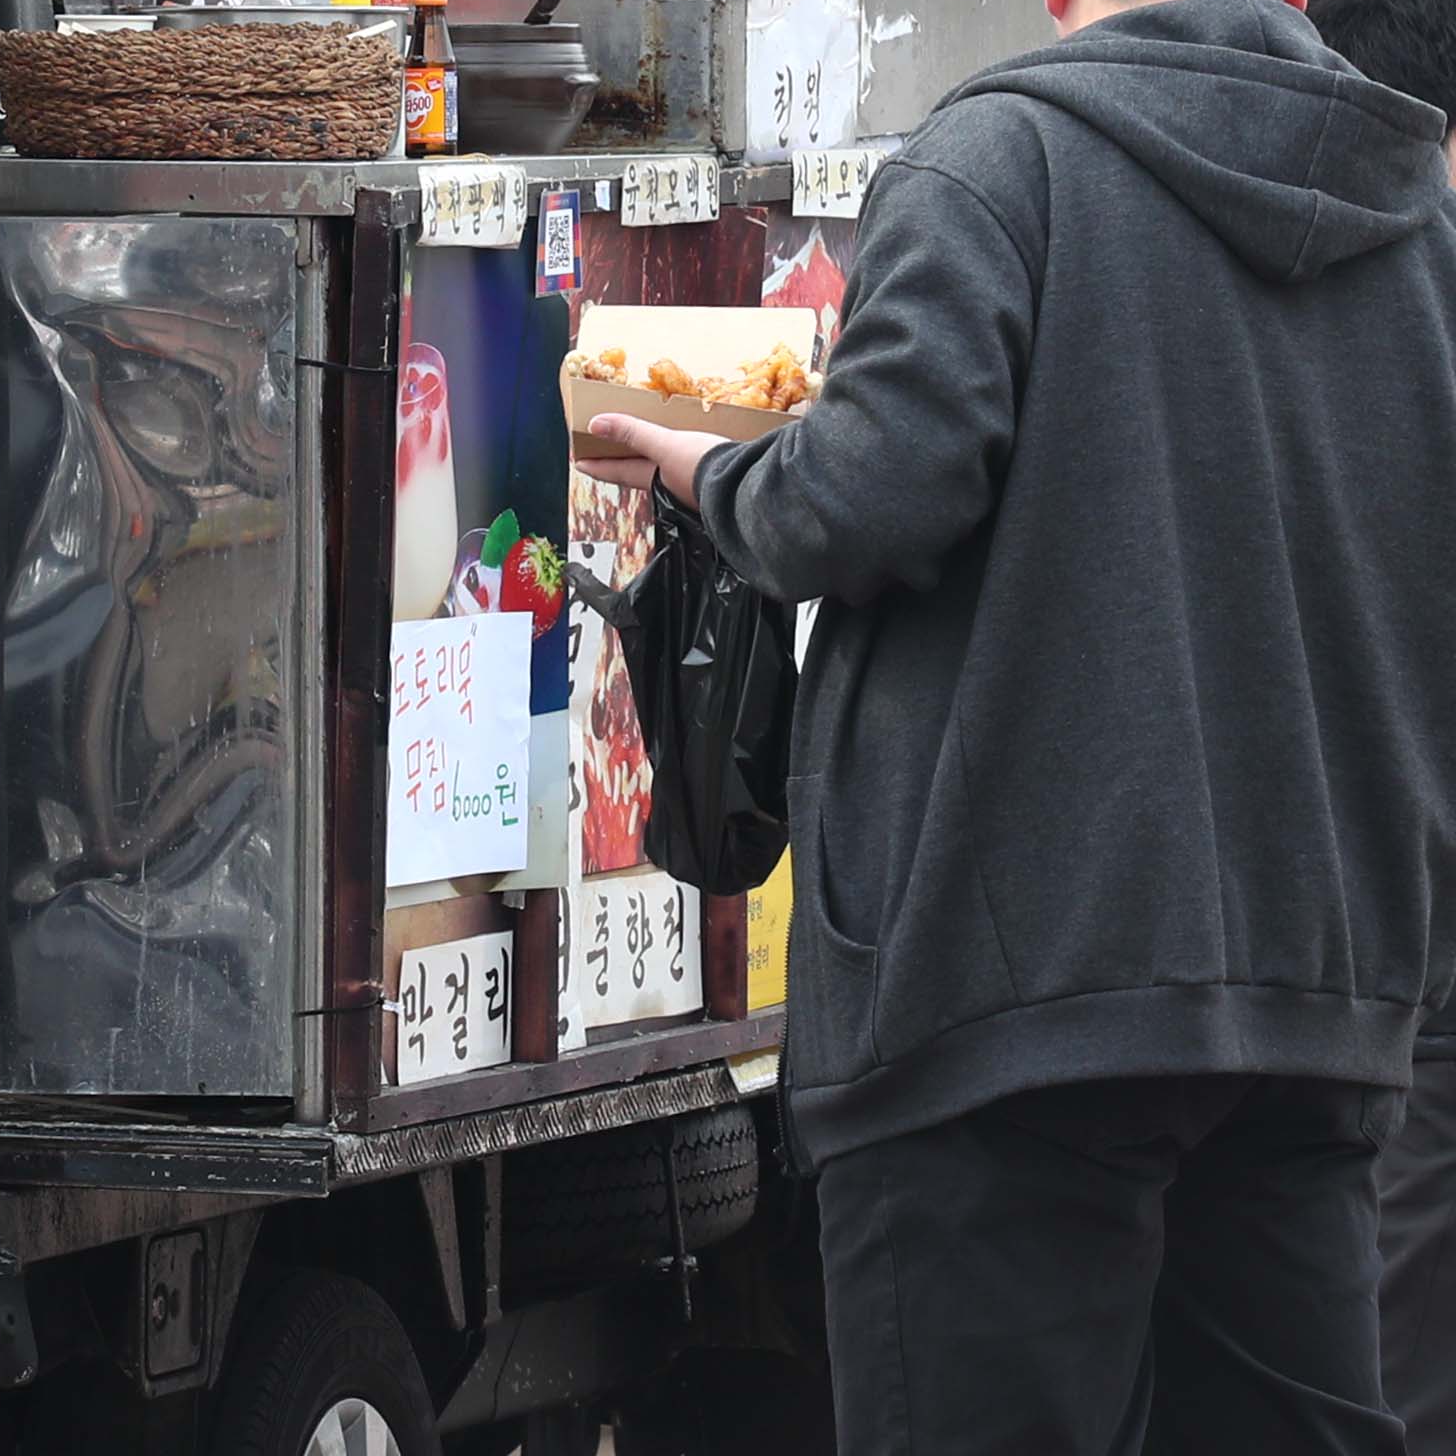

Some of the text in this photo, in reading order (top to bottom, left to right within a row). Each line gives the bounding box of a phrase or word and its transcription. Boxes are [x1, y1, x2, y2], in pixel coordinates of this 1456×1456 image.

[624, 157, 719, 222] 육천오백원
[794, 152, 872, 210] 사천오백
[405, 736, 519, 827] 무침 6000원
[585, 885, 685, 997] 춘향전
[400, 947, 509, 1066] 막걸리
